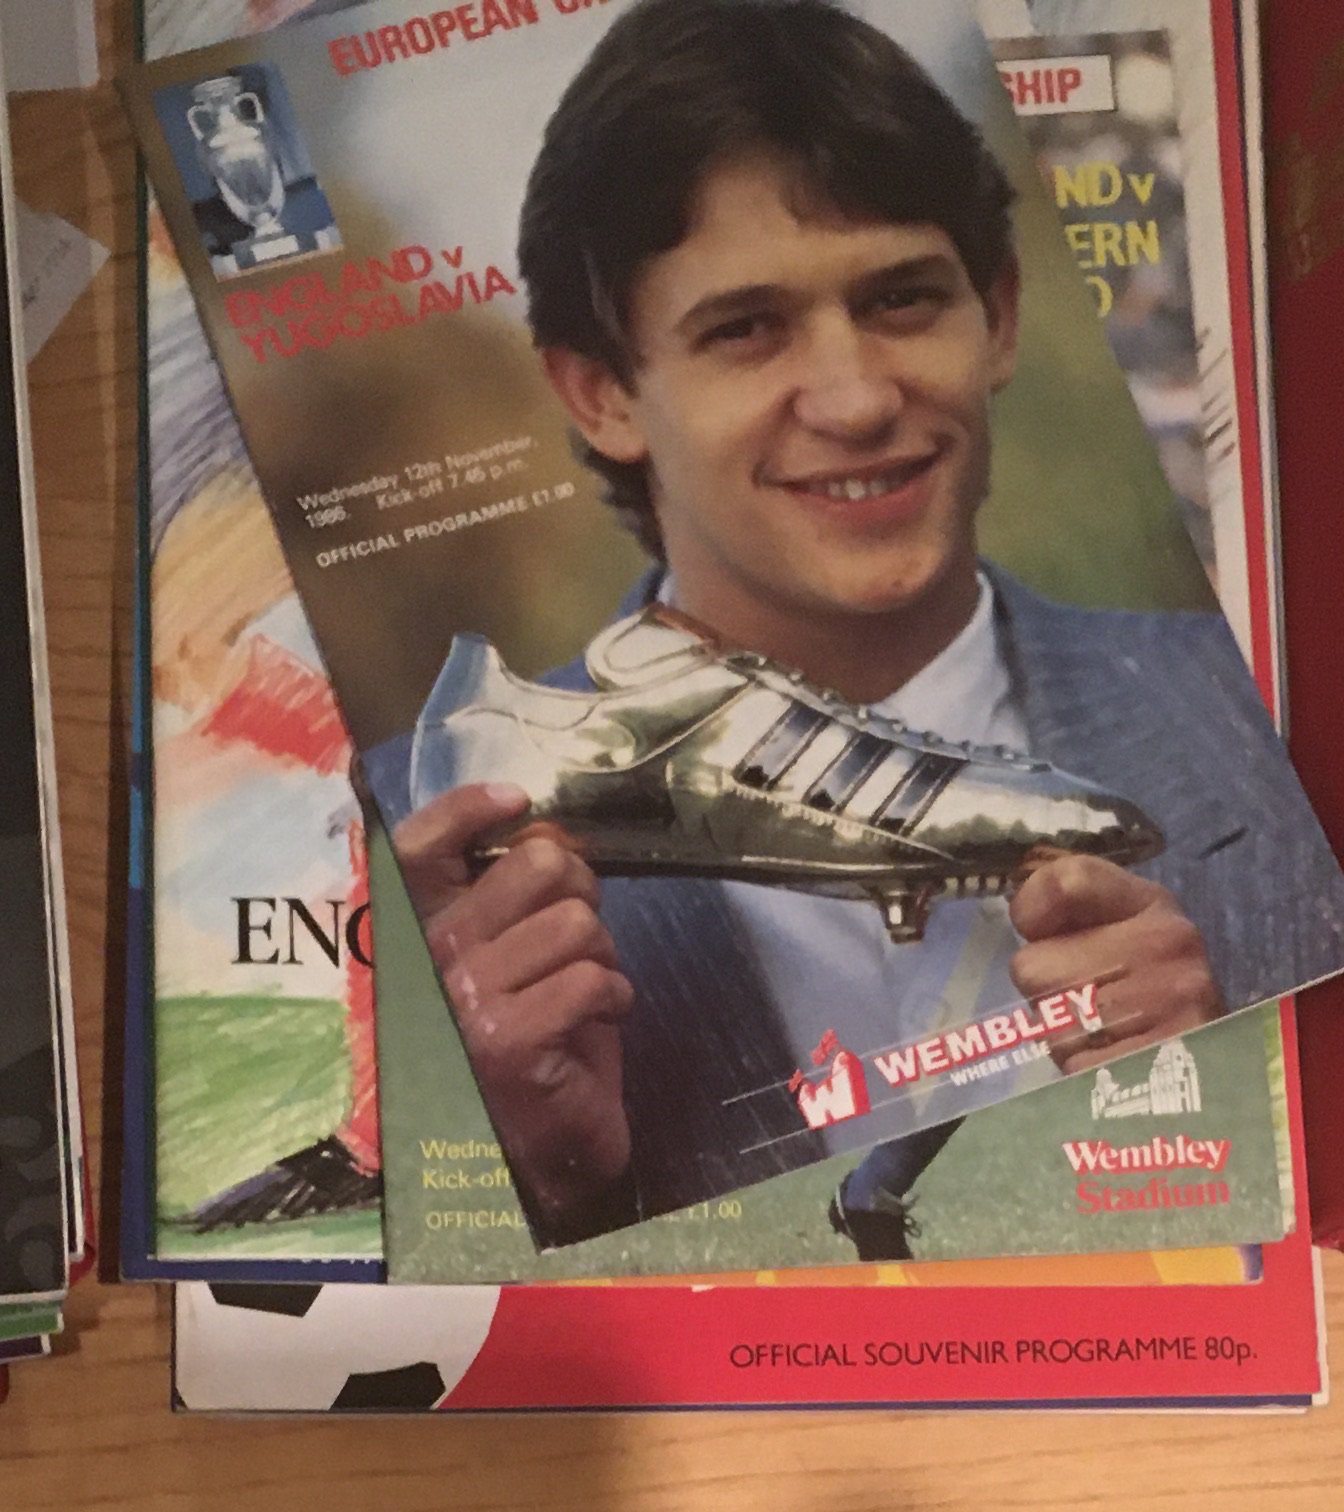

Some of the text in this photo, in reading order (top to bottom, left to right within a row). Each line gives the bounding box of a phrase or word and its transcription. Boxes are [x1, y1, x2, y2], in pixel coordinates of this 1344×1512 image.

[327, 0, 539, 77] EUROPEAN
[1127, 173, 1156, 206] v
[224, 245, 464, 328] ENGLAND v
[239, 265, 517, 364] YUGOSLAVIA
[296, 473, 399, 511] Wednesday
[405, 461, 442, 481] 12th
[316, 534, 401, 568] OFFICIAL
[404, 497, 528, 543] PROGRAMME
[874, 984, 1102, 1087] WEMBLEY
[950, 1056, 1010, 1086] WHERE
[1061, 1133, 1232, 1176] Wembley
[1075, 1176, 1230, 1215] Stadium
[729, 1336, 1258, 1370] OFFICIAL SOUVENIR PROGRAMME 80p.
